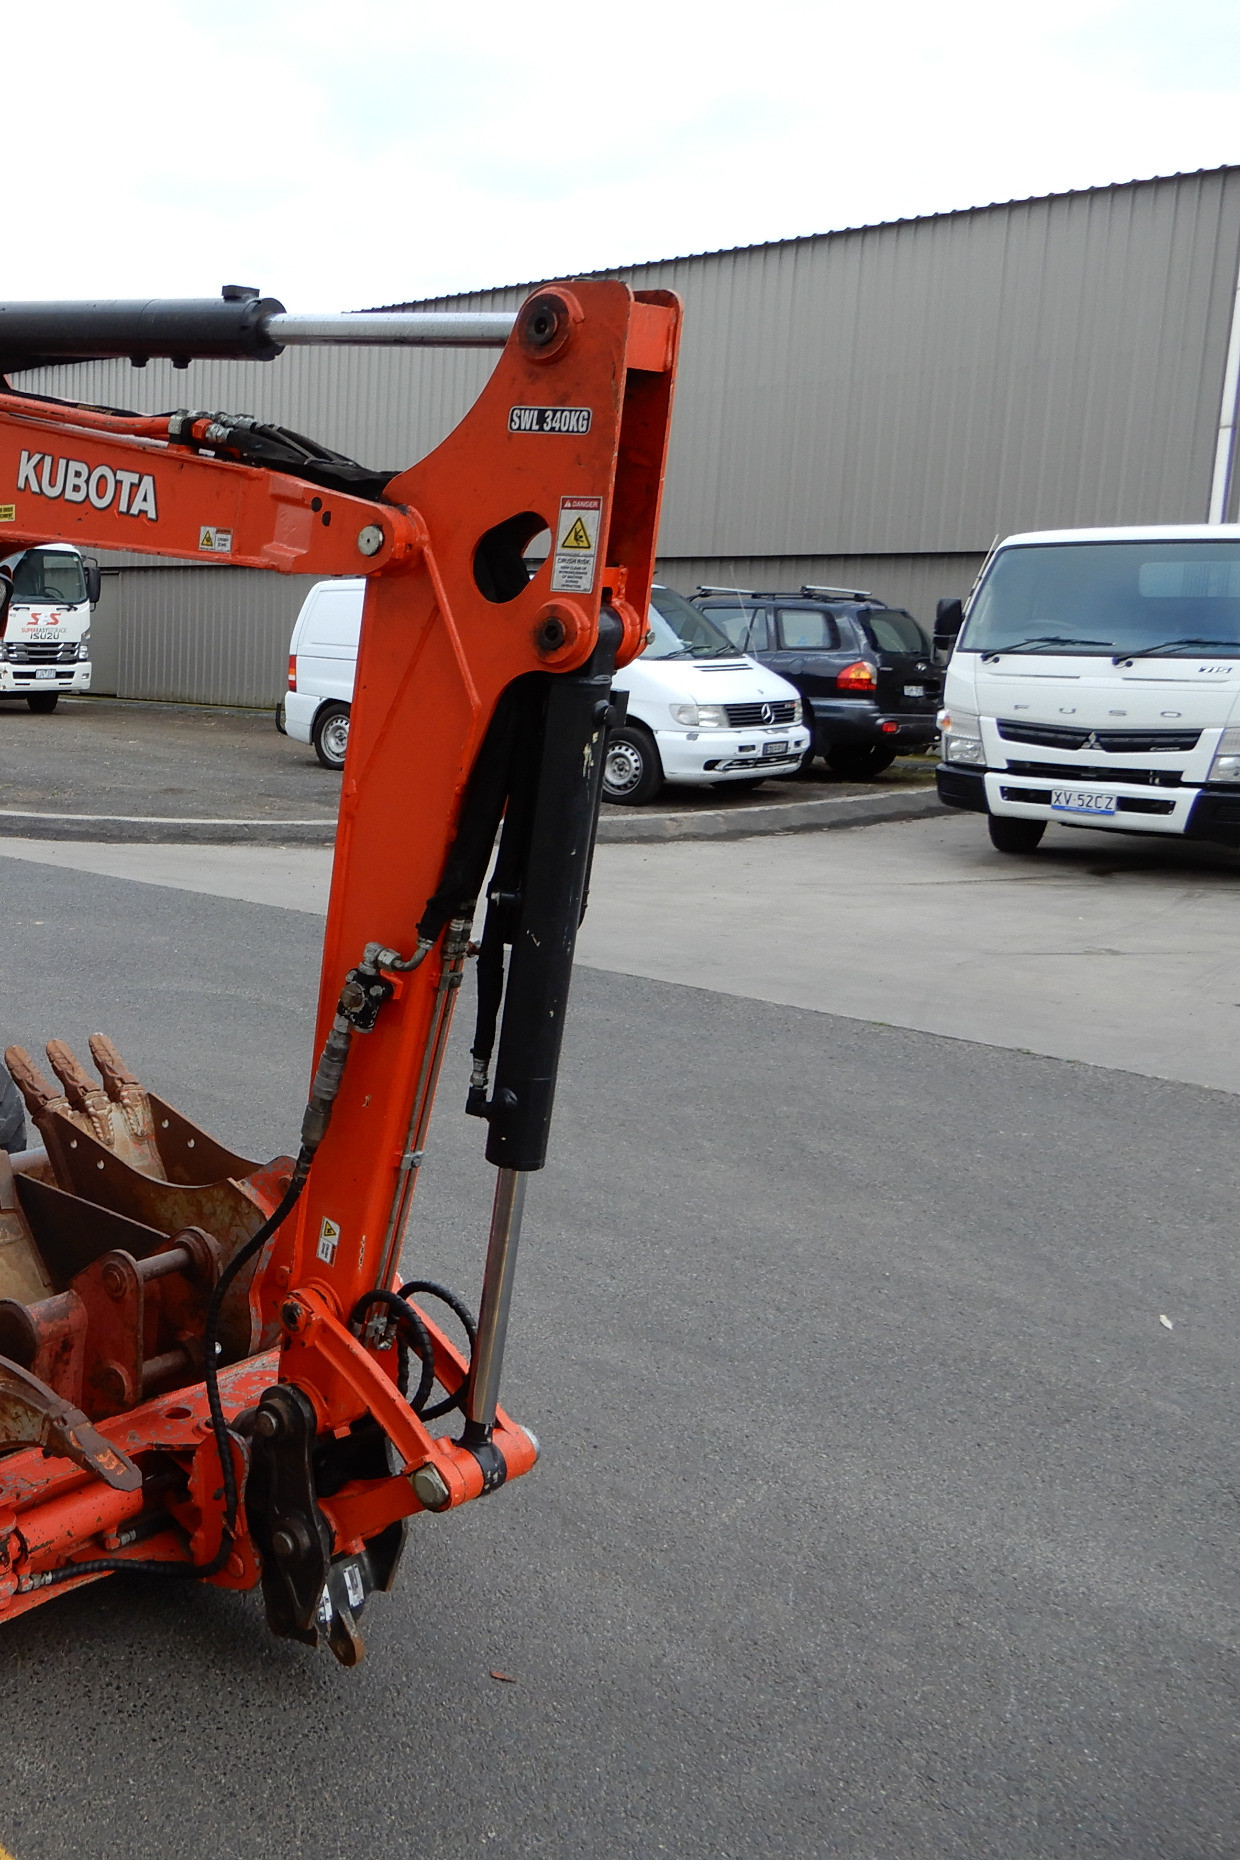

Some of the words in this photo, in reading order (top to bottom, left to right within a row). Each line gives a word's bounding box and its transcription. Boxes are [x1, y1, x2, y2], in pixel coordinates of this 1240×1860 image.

[511, 409, 539, 430] SWL
[543, 411, 589, 432] 340KG
[17, 449, 158, 521] KUBOTA
[1014, 704, 1182, 718] FUSO
